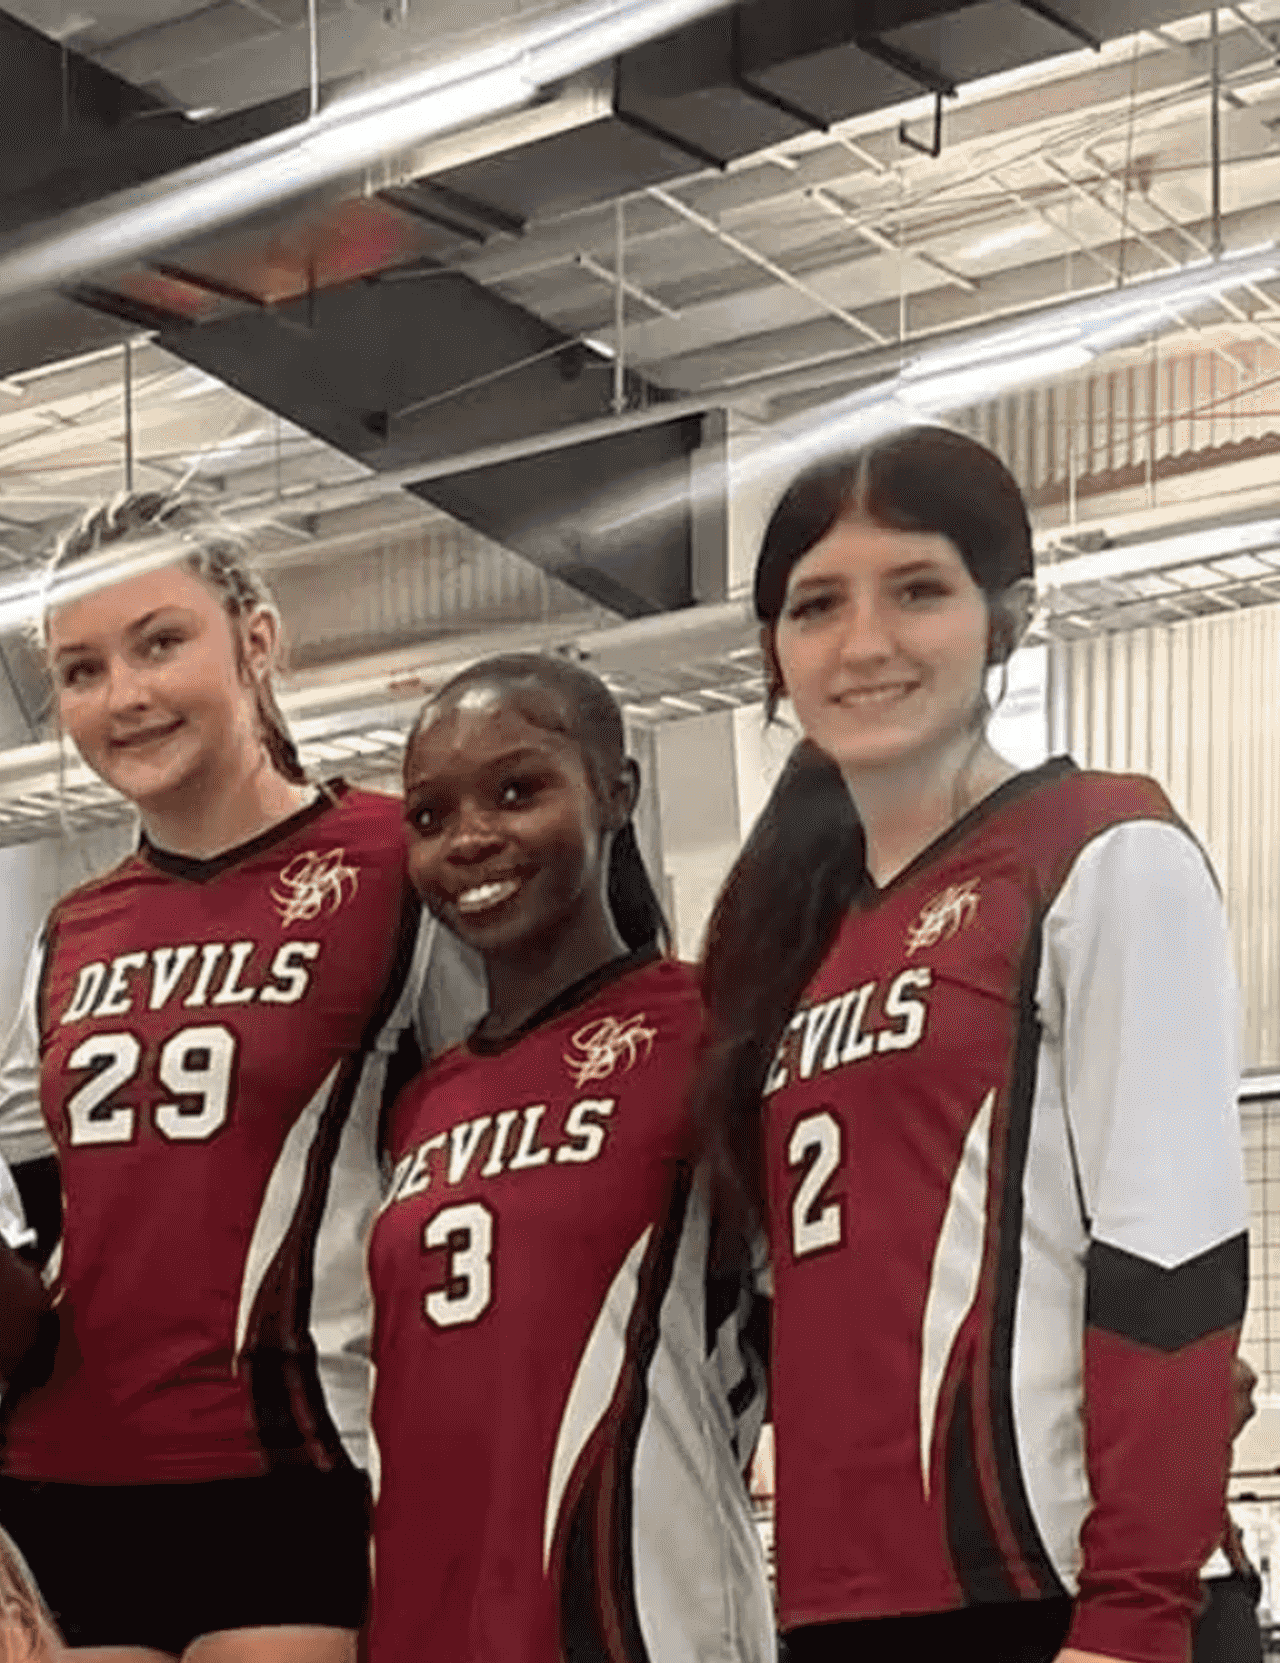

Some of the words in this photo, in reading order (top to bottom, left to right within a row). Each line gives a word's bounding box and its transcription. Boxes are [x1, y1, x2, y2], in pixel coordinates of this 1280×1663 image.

[60, 941, 320, 1025] DEVILS
[762, 967, 931, 1096] EVILS
[67, 1026, 236, 1146] 29
[789, 1113, 841, 1256] 2
[424, 1203, 492, 1327] 3
